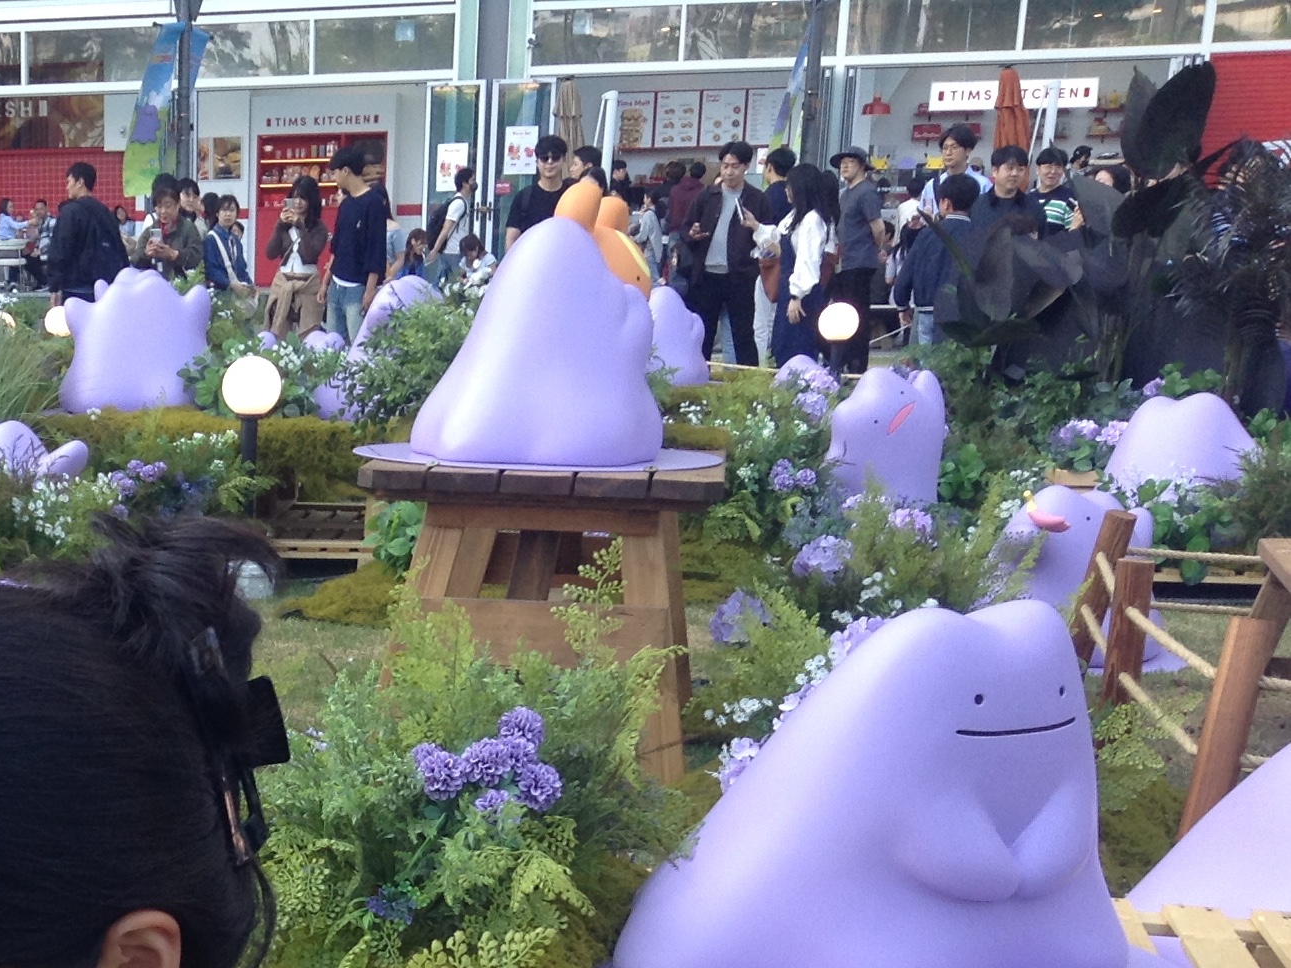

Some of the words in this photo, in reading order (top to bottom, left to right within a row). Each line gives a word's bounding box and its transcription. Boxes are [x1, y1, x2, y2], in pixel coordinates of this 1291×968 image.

[950, 90, 992, 101] TIMS
[1020, 87, 1079, 100] TCHEN
[275, 117, 307, 127] TIMS
[313, 115, 371, 126] KITCHEN
